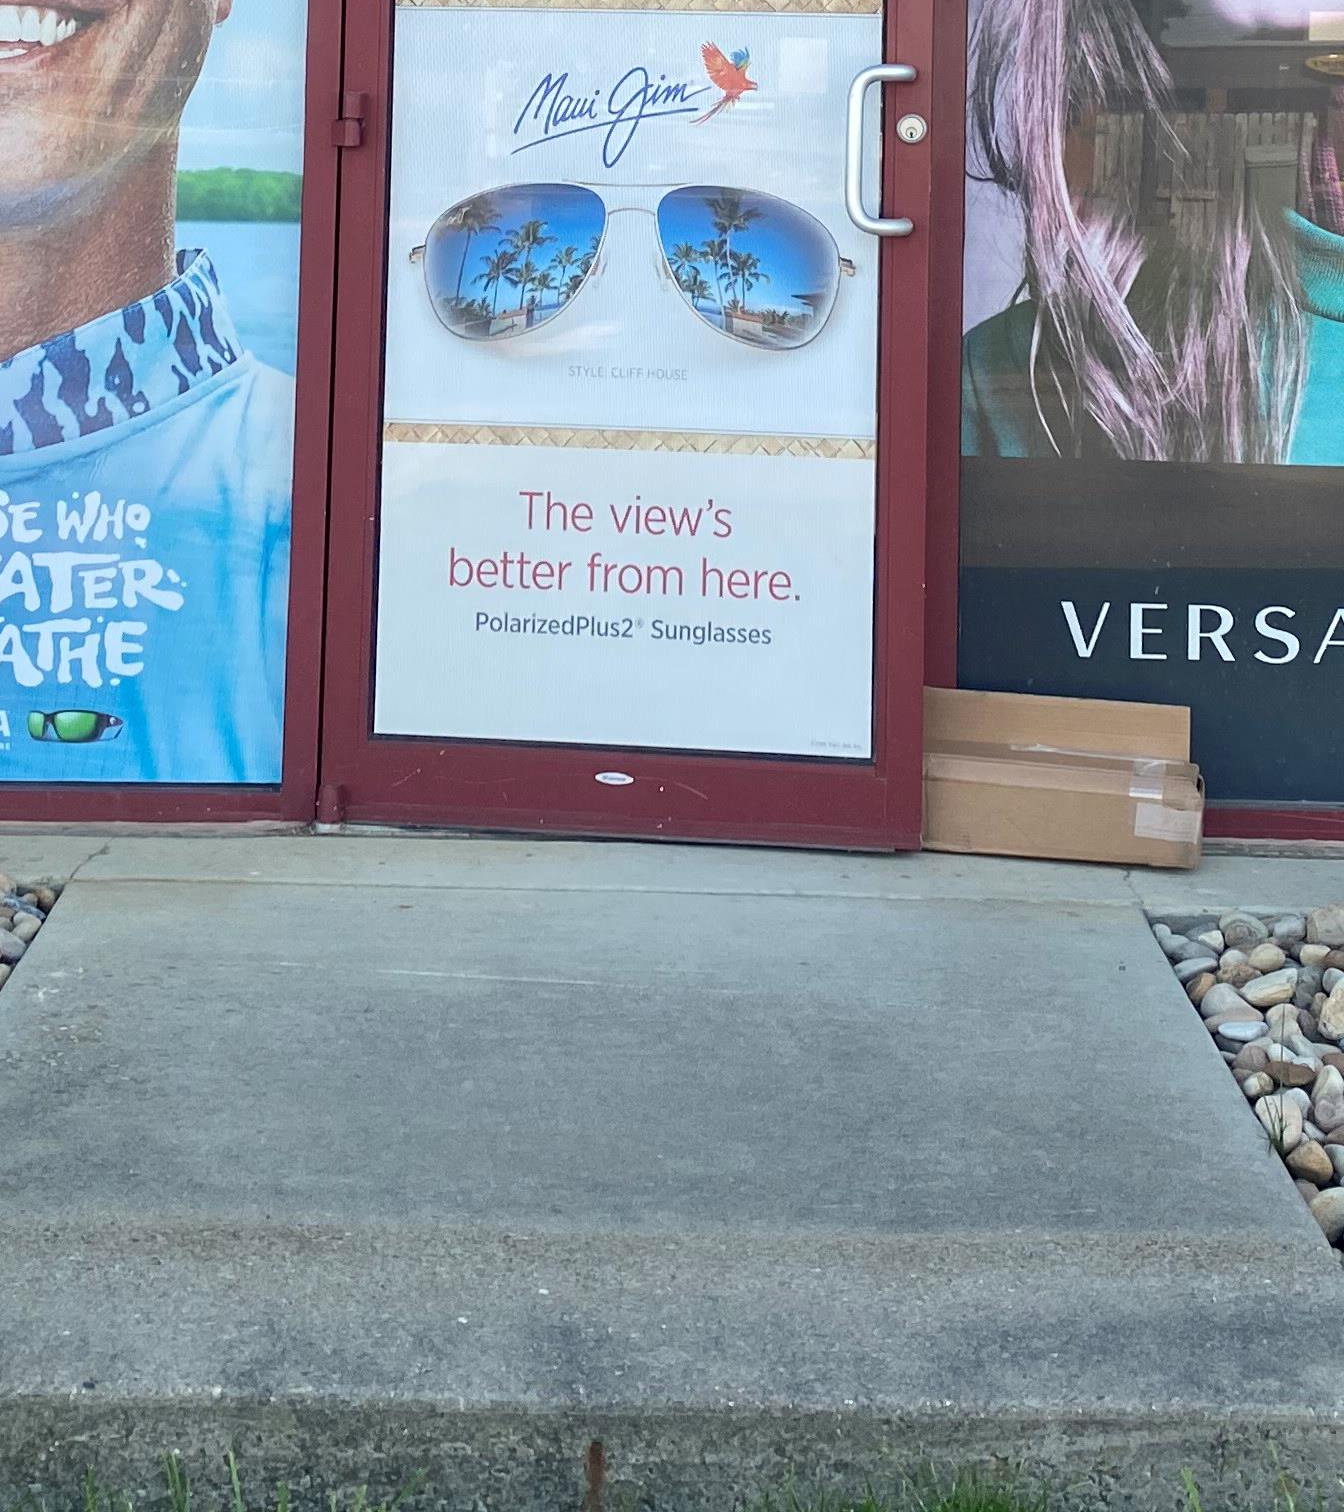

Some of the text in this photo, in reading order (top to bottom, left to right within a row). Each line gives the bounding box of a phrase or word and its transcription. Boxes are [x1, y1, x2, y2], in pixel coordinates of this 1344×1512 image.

[513, 66, 712, 169] Maui Jim
[611, 366, 644, 379] CLIFF
[647, 367, 689, 381] HOUSE
[57, 489, 151, 543] WHO
[518, 490, 734, 539] The view's
[448, 546, 802, 602] better from here.
[649, 618, 773, 646] Sunglasses
